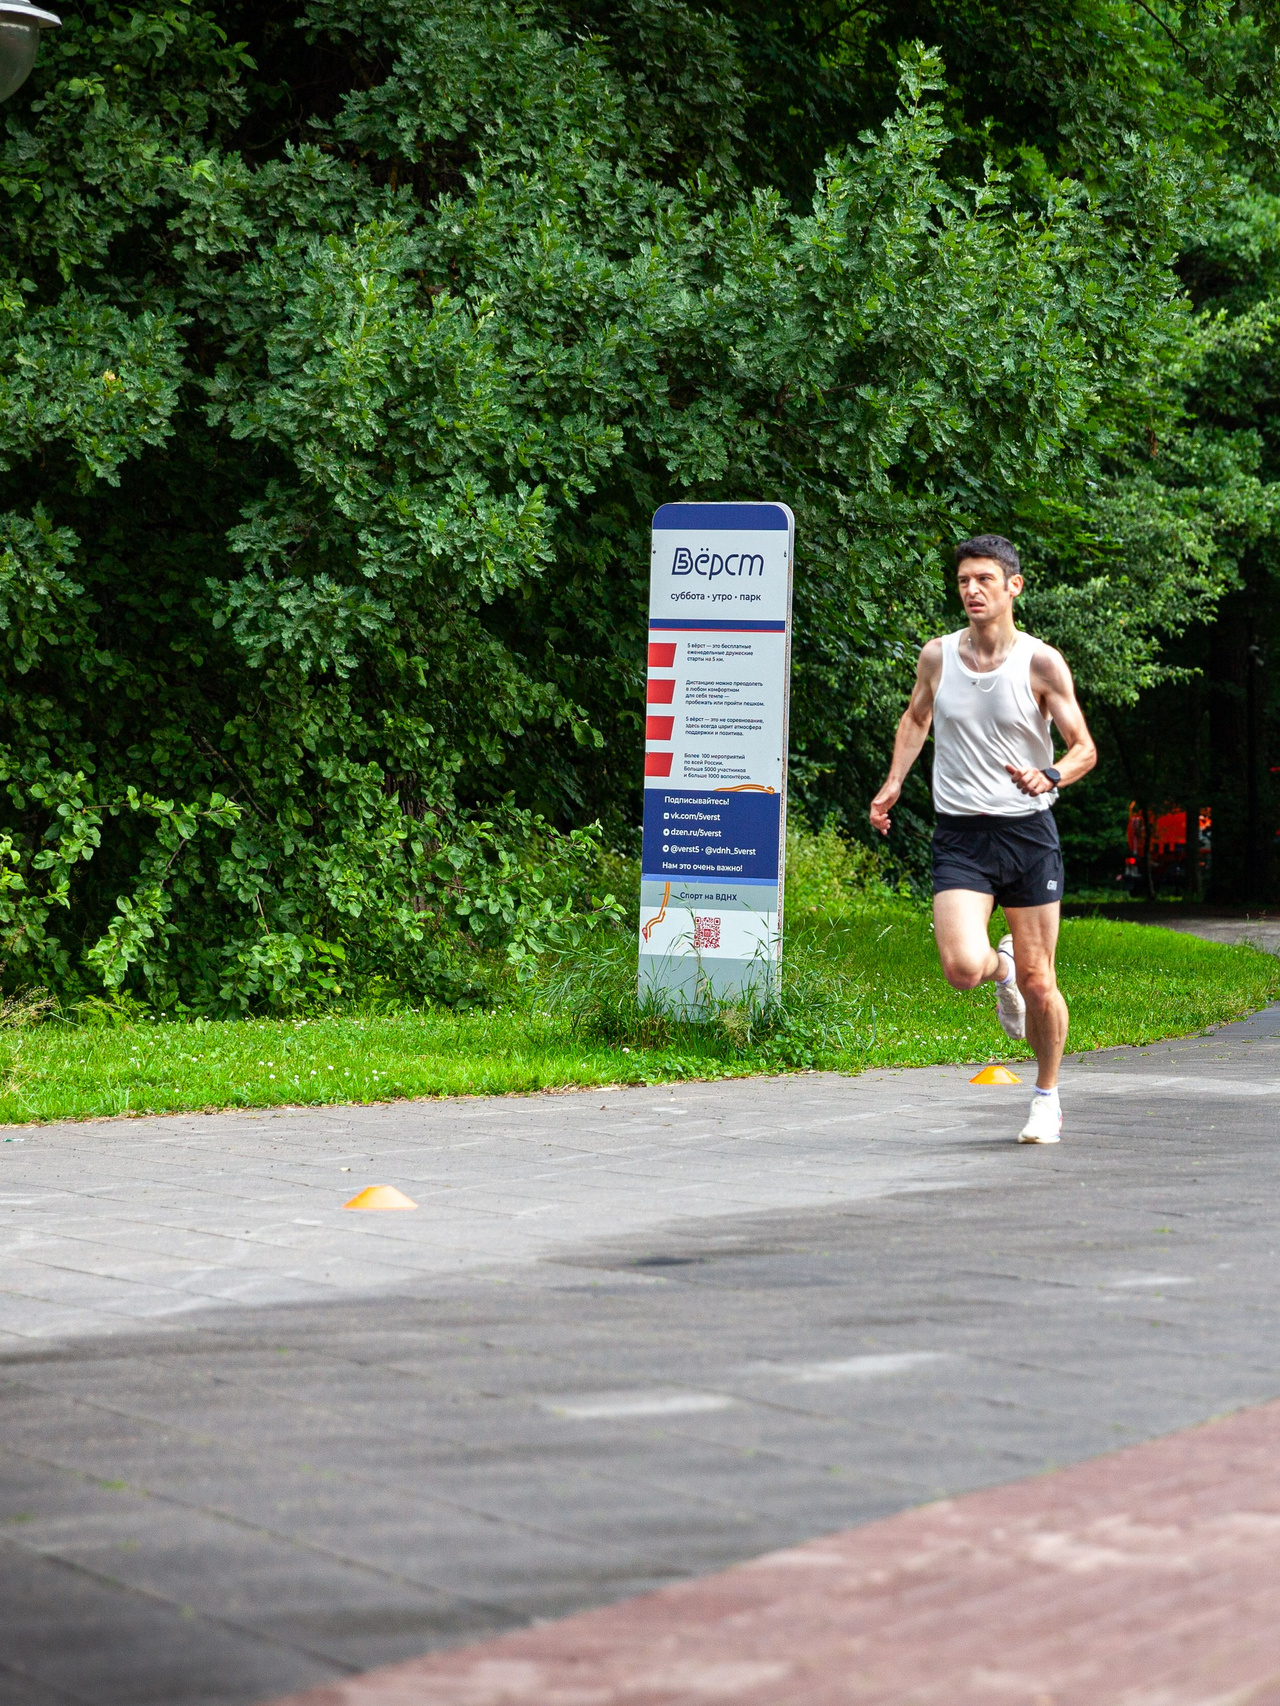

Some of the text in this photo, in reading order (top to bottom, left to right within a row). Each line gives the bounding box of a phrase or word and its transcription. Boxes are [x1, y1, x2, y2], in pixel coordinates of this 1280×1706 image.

[670, 592, 761, 602] суббота утро парк
[664, 796, 729, 805] Подписывайтесь!
[671, 812, 720, 820] vk.com/5verst
[671, 828, 721, 837] dzen.ru/5verst
[671, 845, 756, 855] @verst5 @vdnh_5verst
[680, 892, 702, 900] Спорт
